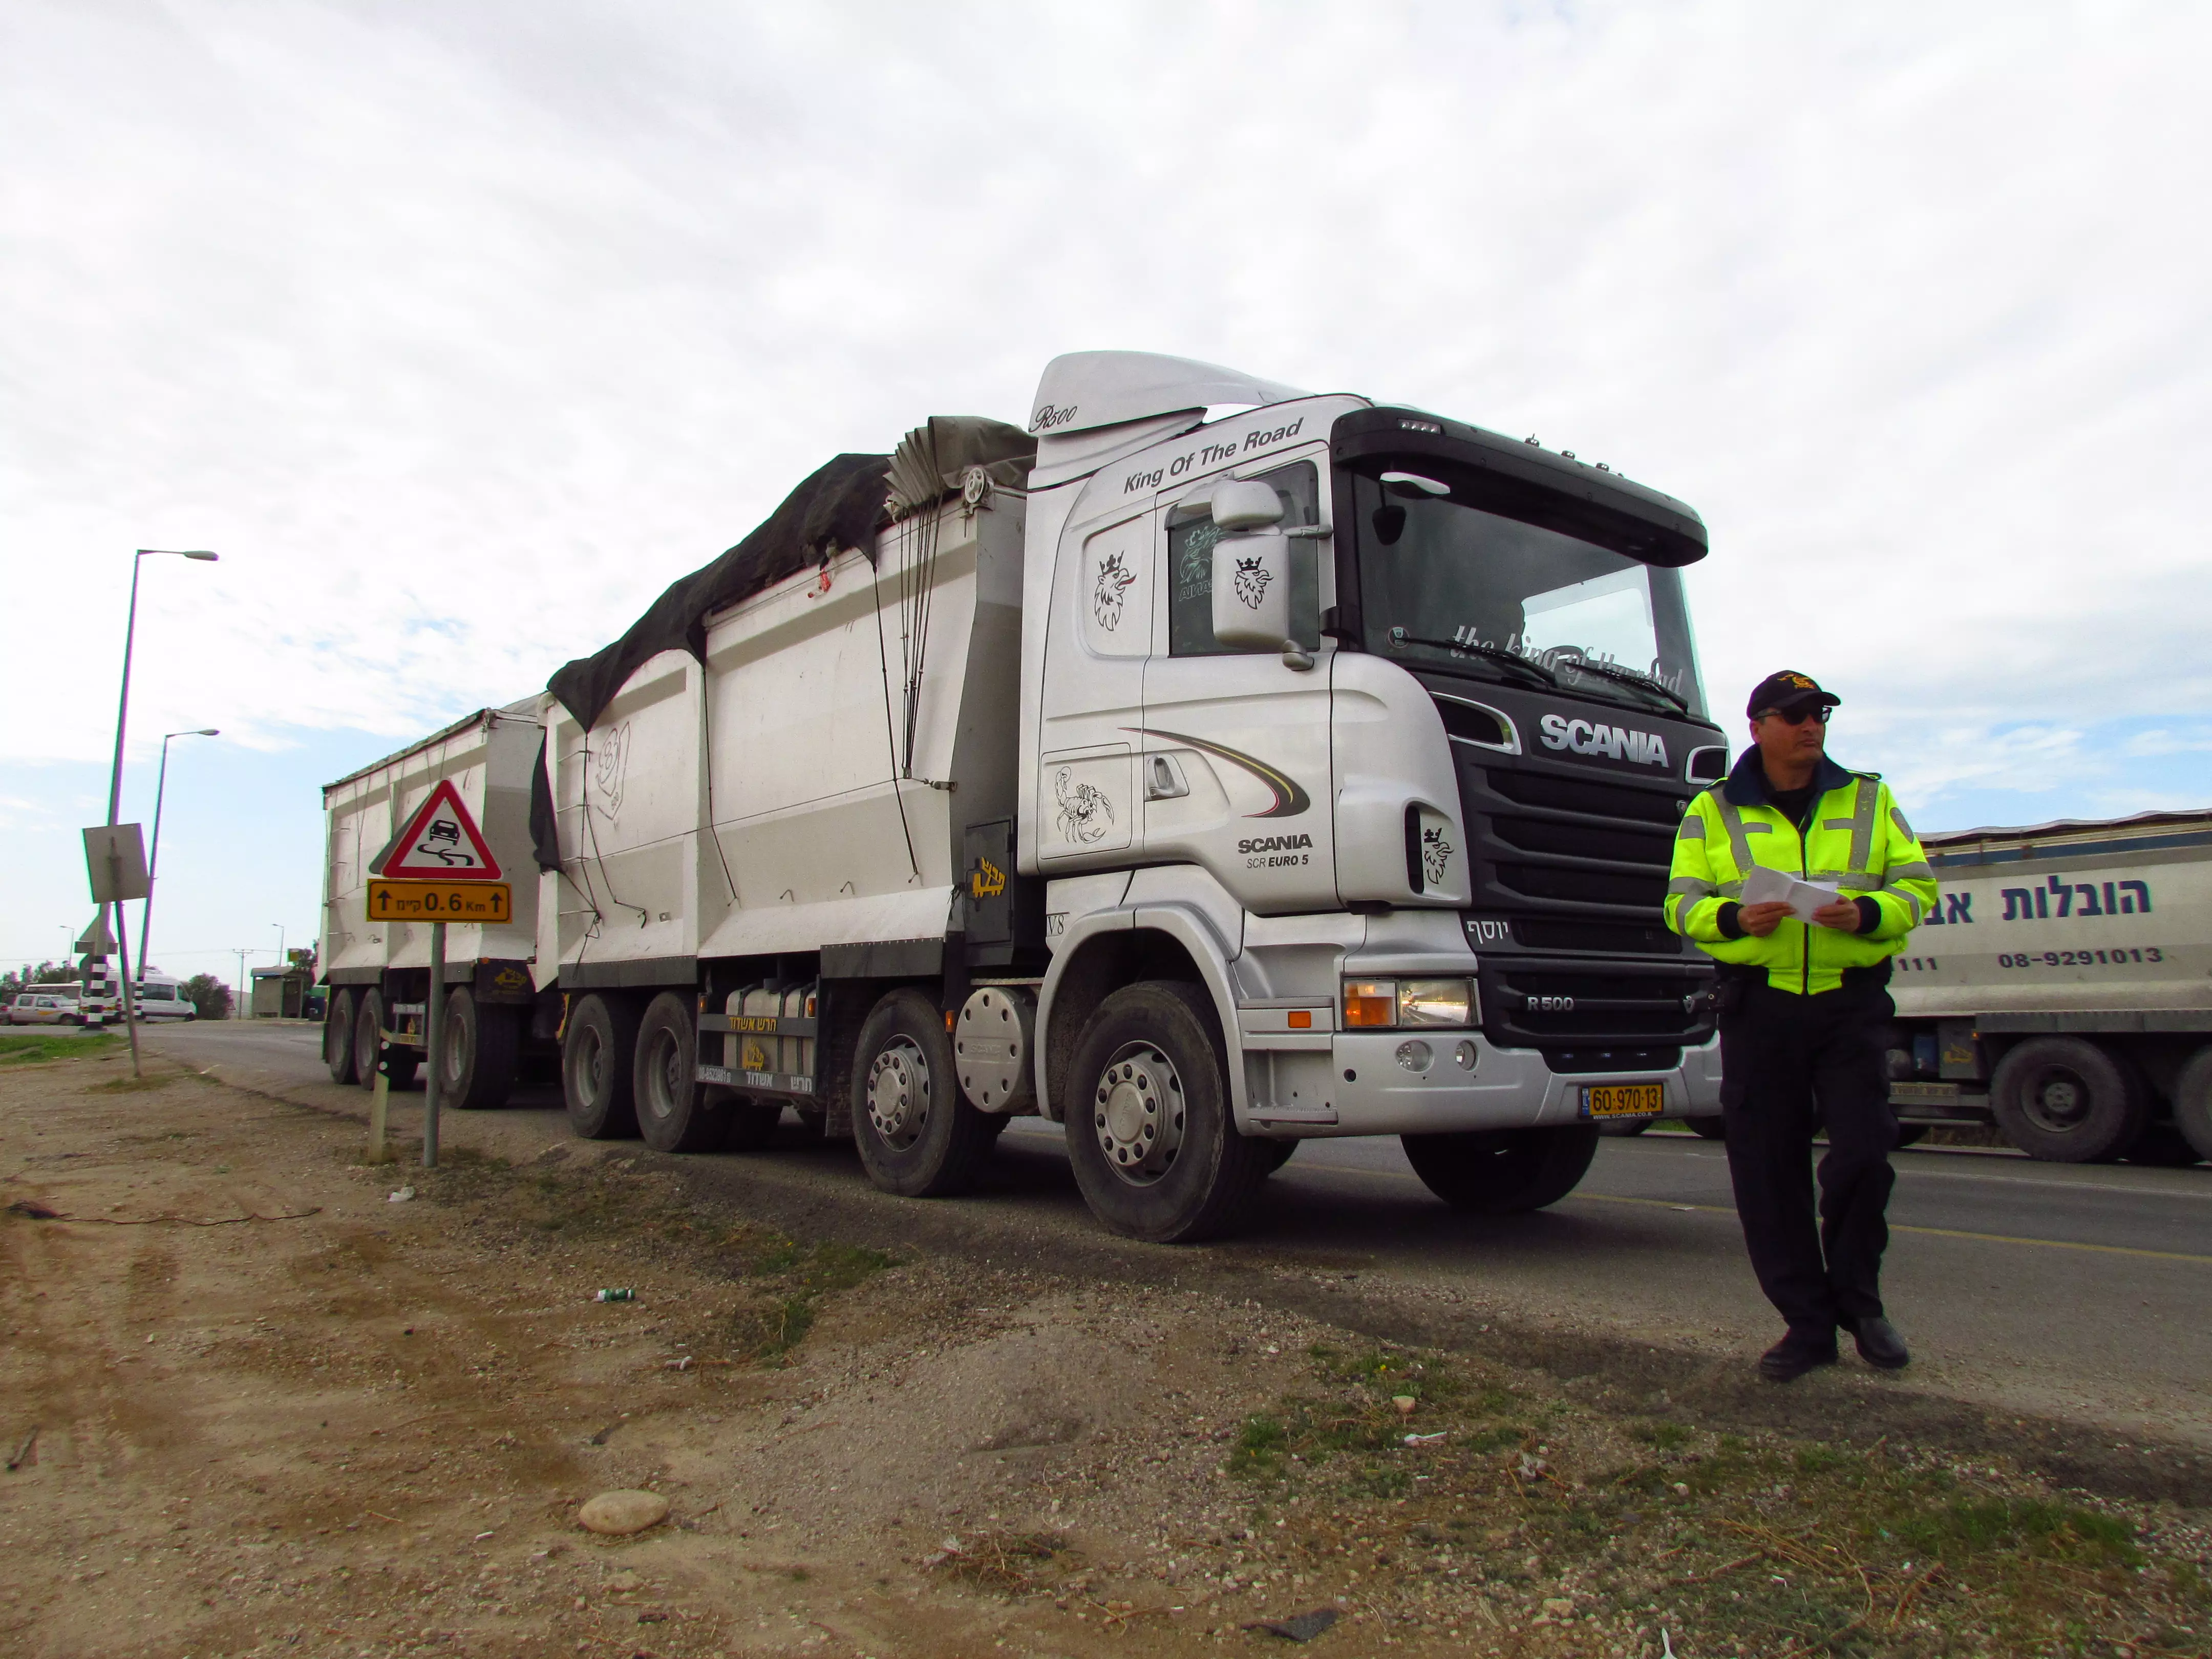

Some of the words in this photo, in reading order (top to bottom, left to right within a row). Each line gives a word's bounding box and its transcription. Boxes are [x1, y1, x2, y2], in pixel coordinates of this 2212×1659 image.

[1028, 404, 1077, 433] R500
[1123, 468, 1164, 494] King
[1170, 452, 1196, 476] Of
[1201, 443, 1237, 465] The
[1243, 416, 1304, 452] Road
[1539, 714, 1669, 768] SCANIA
[1238, 834, 1313, 854] SCANIA
[1247, 858, 1266, 869] SCR
[1268, 855, 1299, 867] EURO
[1302, 855, 1309, 865] 5
[424, 892, 462, 911] 0.6
[466, 901, 486, 912] Km
[1920, 891, 1973, 926] אב
[2001, 875, 2152, 921] הובלות
[1048, 914, 1064, 935] V8
[1466, 921, 1509, 944] יוסף
[1998, 947, 2163, 968] 08-9291013
[746, 1070, 773, 1088] אשדוד
[790, 1075, 813, 1092] חרש
